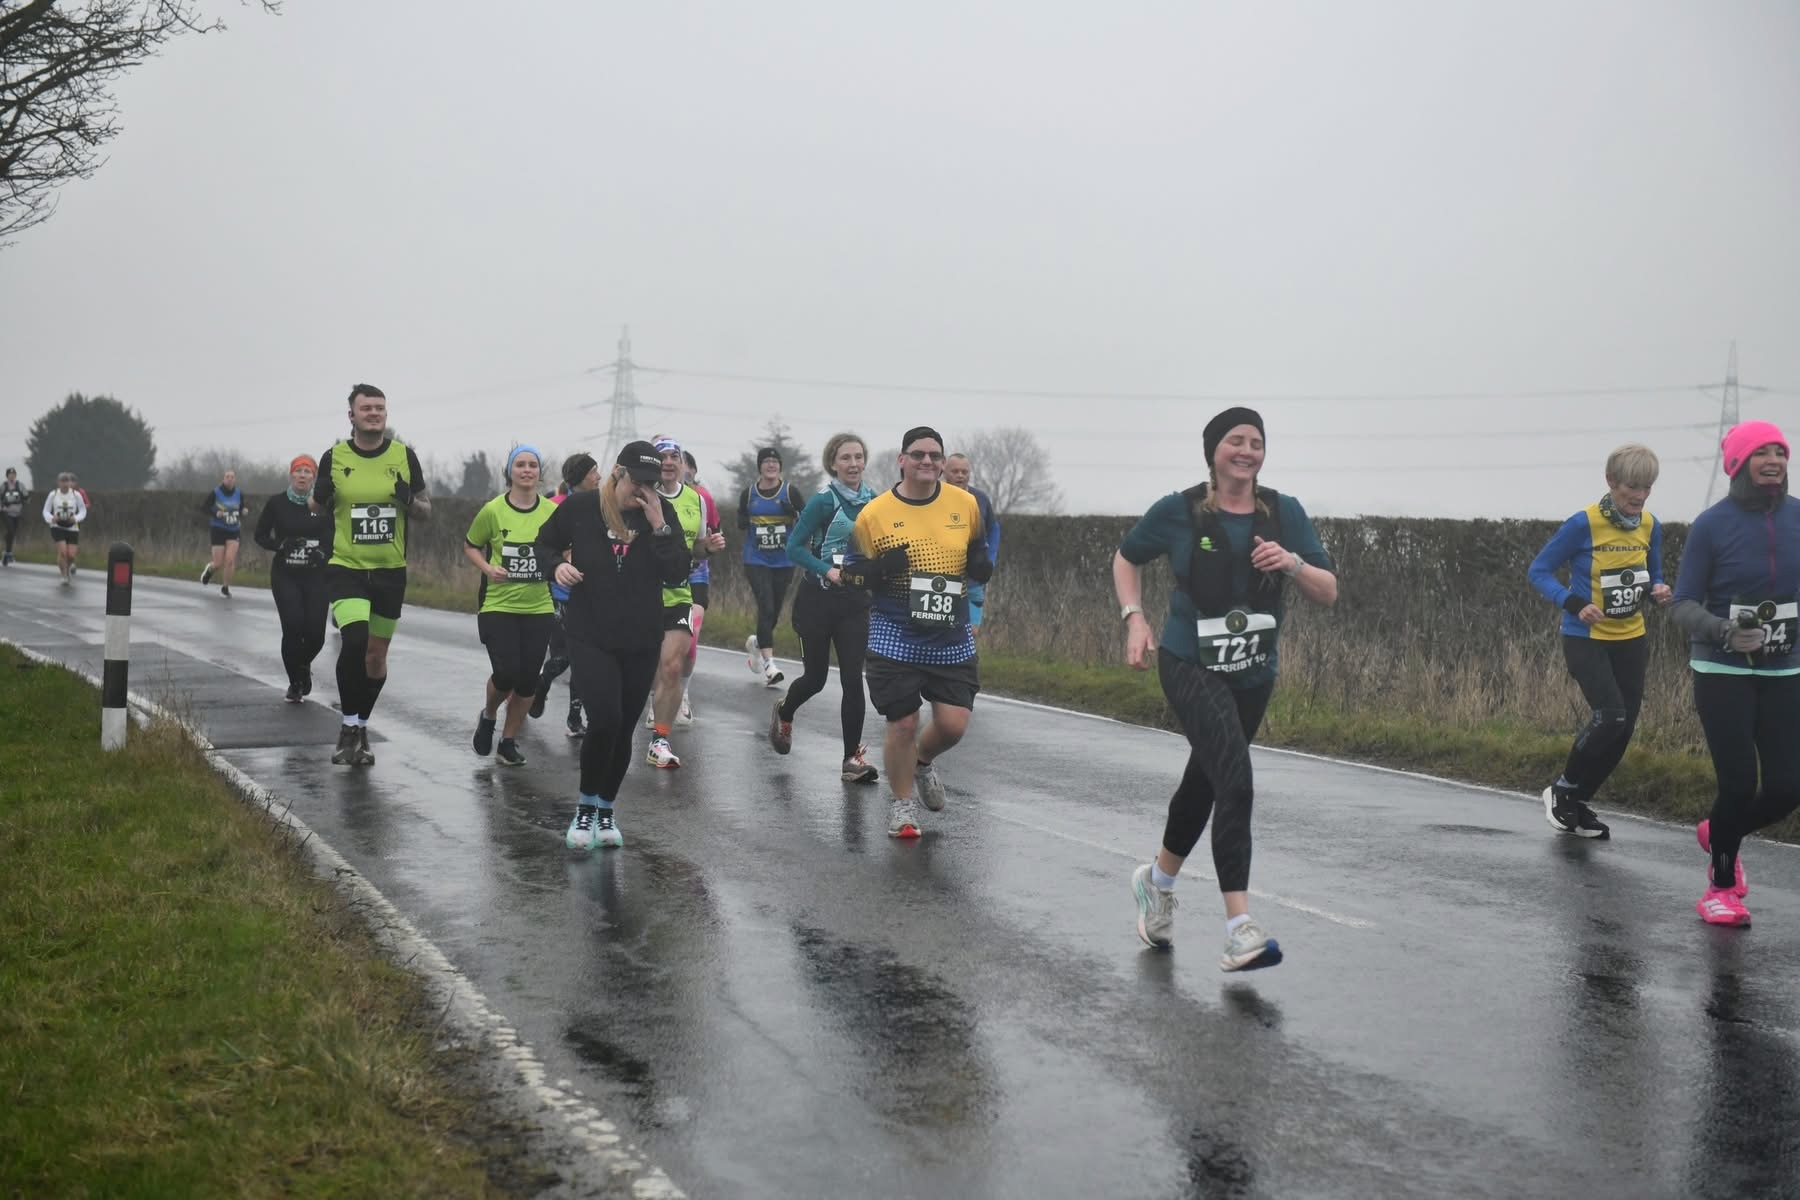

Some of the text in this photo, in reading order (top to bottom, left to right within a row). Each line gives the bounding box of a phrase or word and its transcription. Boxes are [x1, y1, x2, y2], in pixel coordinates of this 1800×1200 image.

[359, 519, 389, 534] 116
[761, 534, 781, 545] 811
[509, 558, 537, 572] 528
[920, 593, 953, 613] 138
[1611, 586, 1644, 607] 390
[911, 611, 946, 621] FERRIBY
[1212, 634, 1260, 663] 721
